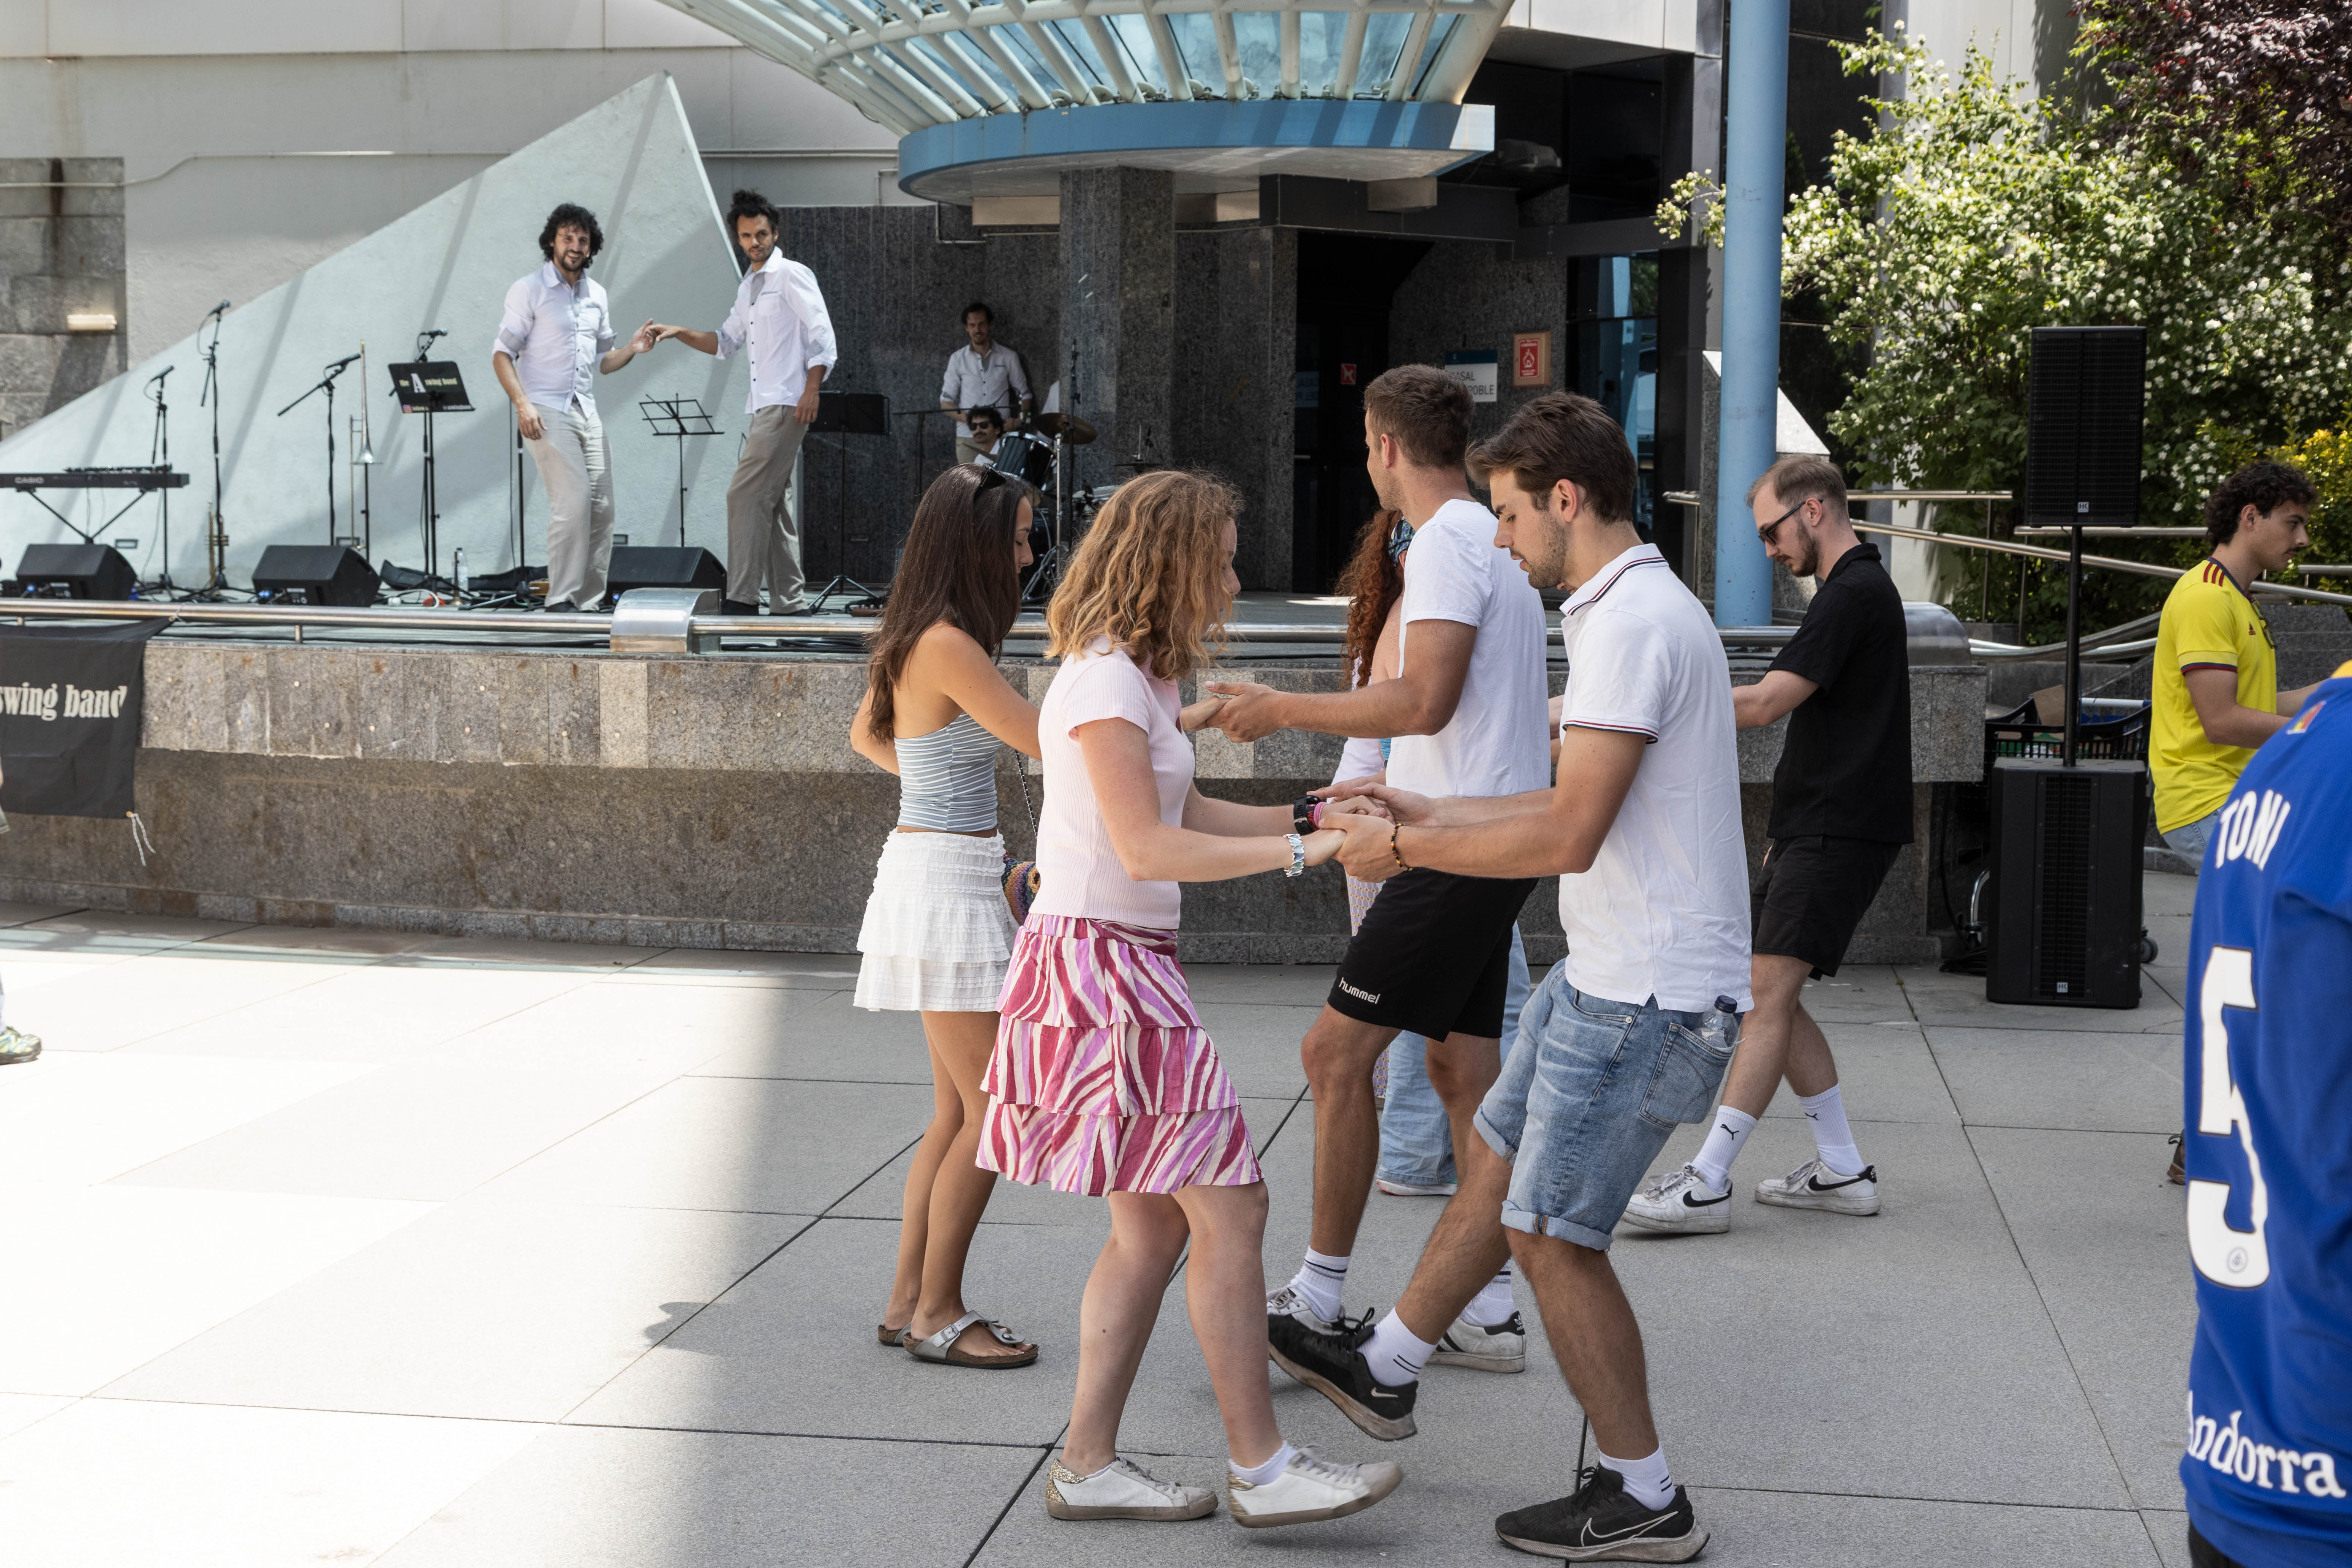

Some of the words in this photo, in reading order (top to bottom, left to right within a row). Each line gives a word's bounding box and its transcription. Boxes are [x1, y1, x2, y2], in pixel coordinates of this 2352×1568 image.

[410, 373, 426, 393] A
[63, 684, 127, 718] band
[2215, 789, 2291, 871] TONI
[1339, 977, 1380, 1004] hummel
[2187, 945, 2270, 1288] 5
